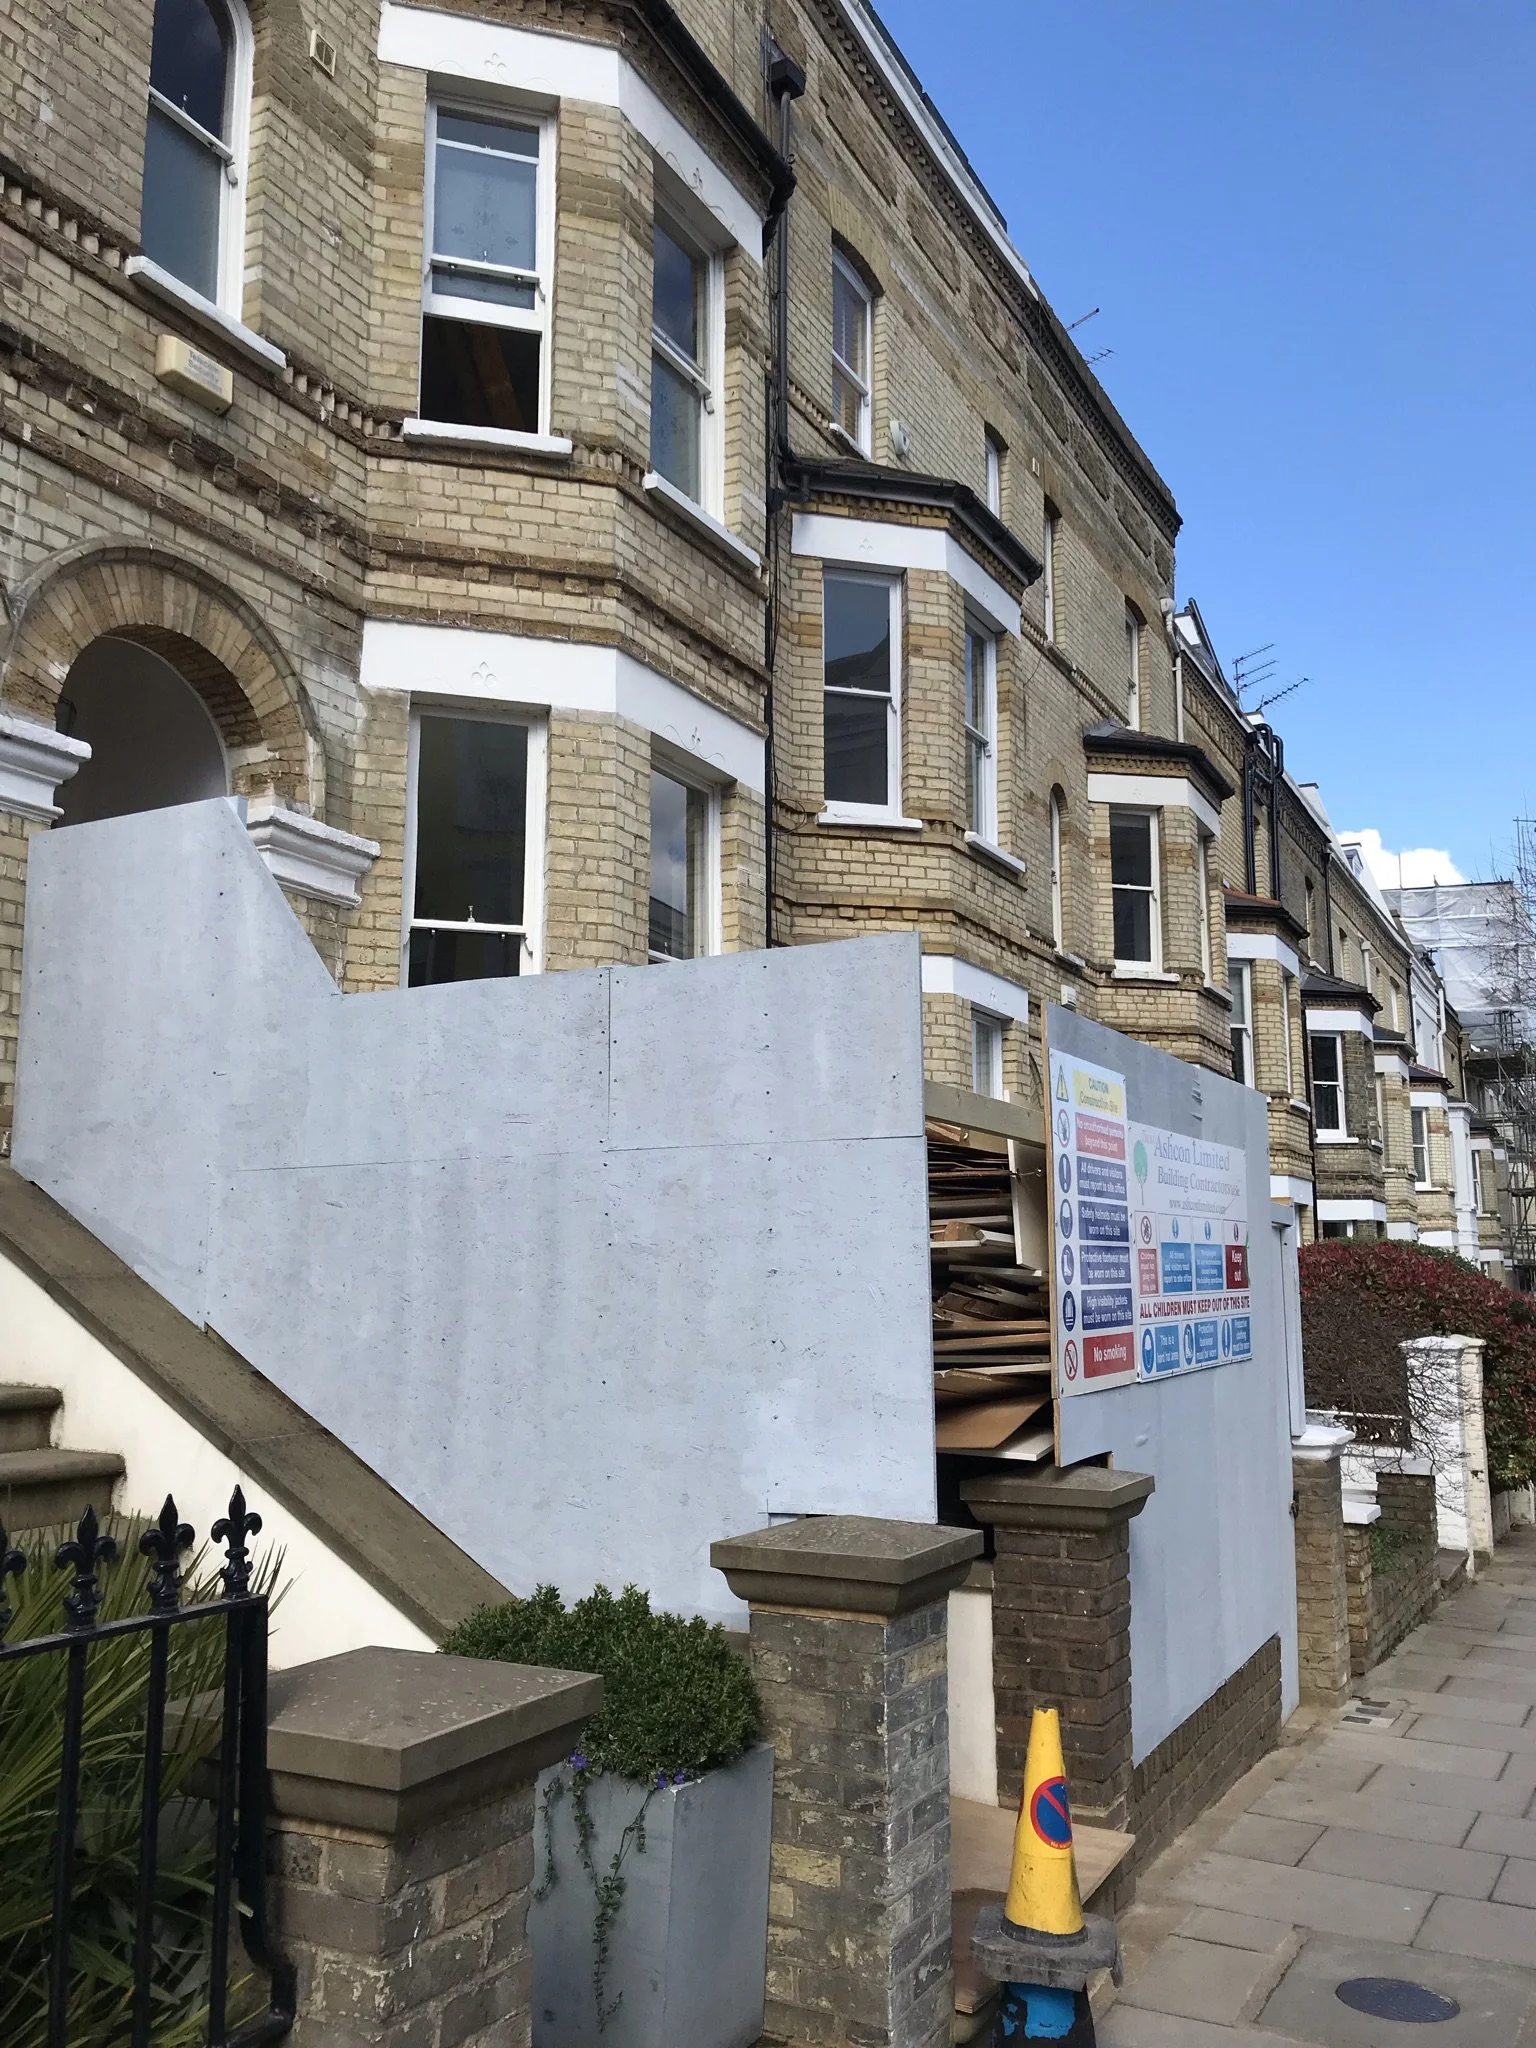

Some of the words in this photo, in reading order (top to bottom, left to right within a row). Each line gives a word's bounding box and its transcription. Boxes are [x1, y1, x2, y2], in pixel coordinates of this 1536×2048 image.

[1088, 1077, 1109, 1095] CAUTION
[1085, 1135, 1100, 1149] beyond
[1108, 1141, 1118, 1152] point
[1154, 1135, 1190, 1164] Ashcon
[1192, 1142, 1230, 1171] Limited
[1087, 1162, 1101, 1176] drivers
[1110, 1167, 1123, 1179] visitors
[1079, 1179, 1089, 1189] must
[1090, 1180, 1102, 1192] report
[1115, 1183, 1126, 1194] office
[1157, 1166, 1189, 1193] Building
[1190, 1172, 1230, 1196] Contractors
[1081, 1206, 1094, 1221] Safety
[1095, 1207, 1110, 1221] helmets
[1111, 1210, 1120, 1221] must
[1120, 1210, 1126, 1221] be
[1088, 1225, 1099, 1235] worn
[1081, 1250, 1102, 1263] Protective
[1102, 1251, 1118, 1263] footwear
[1119, 1252, 1129, 1263] must
[1231, 1249, 1242, 1266] Keep
[1087, 1267, 1093, 1278] be
[1094, 1269, 1104, 1278] worn
[1110, 1266, 1118, 1278] this
[1118, 1267, 1126, 1278] site
[1234, 1269, 1242, 1282] out
[1086, 1294, 1097, 1310] High
[1097, 1293, 1114, 1309] visibility
[1114, 1293, 1128, 1309] jackets
[1140, 1303, 1152, 1319] ALL
[1153, 1301, 1181, 1317] CHILDREN
[1182, 1300, 1197, 1315] MUST
[1197, 1299, 1212, 1314] KEEP
[1212, 1298, 1222, 1312] OUT
[1222, 1297, 1230, 1311] OF
[1230, 1296, 1240, 1310] THIS
[1240, 1296, 1250, 1309] SITE
[1083, 1312, 1094, 1324] must
[1095, 1311, 1101, 1323] be
[1101, 1313, 1111, 1322] worn
[1124, 1309, 1132, 1320] site
[1160, 1334, 1168, 1346] This
[1093, 1345, 1103, 1362] No
[1103, 1343, 1127, 1361] smoking
